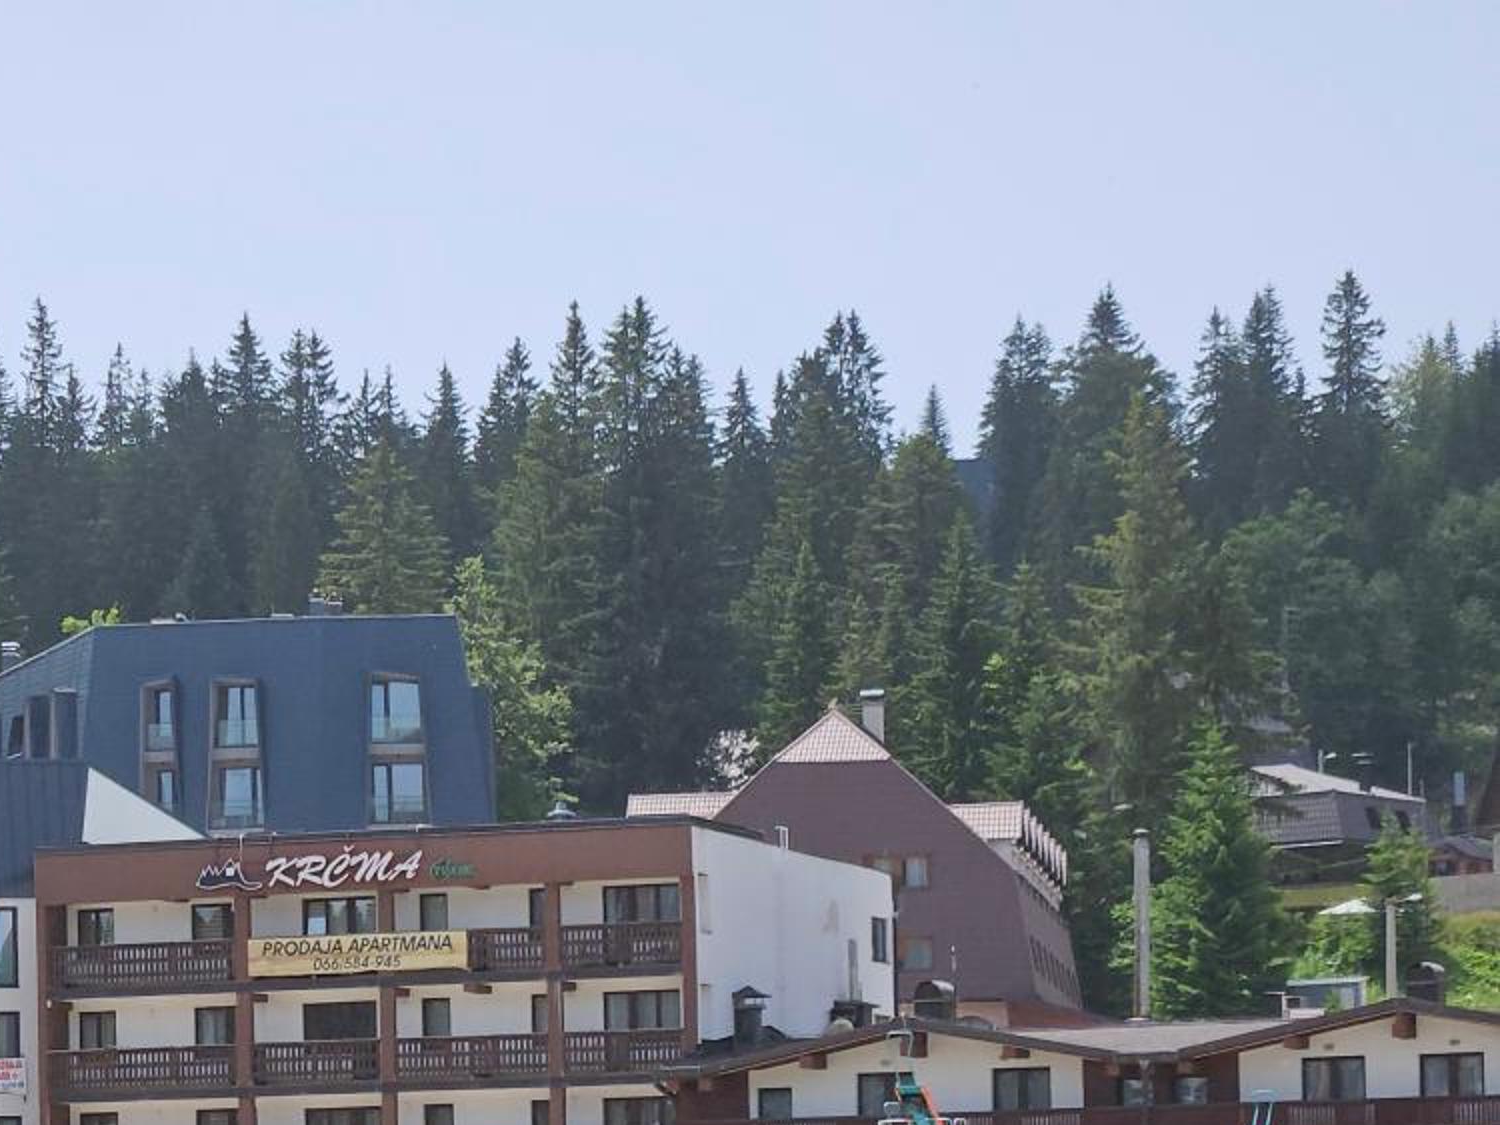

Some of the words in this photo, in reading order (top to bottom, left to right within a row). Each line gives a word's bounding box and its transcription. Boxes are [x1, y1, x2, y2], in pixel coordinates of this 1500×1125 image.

[265, 845, 423, 888] KRČMA
[263, 937, 343, 957] PRODAJA
[348, 934, 452, 954] APARTMANA
